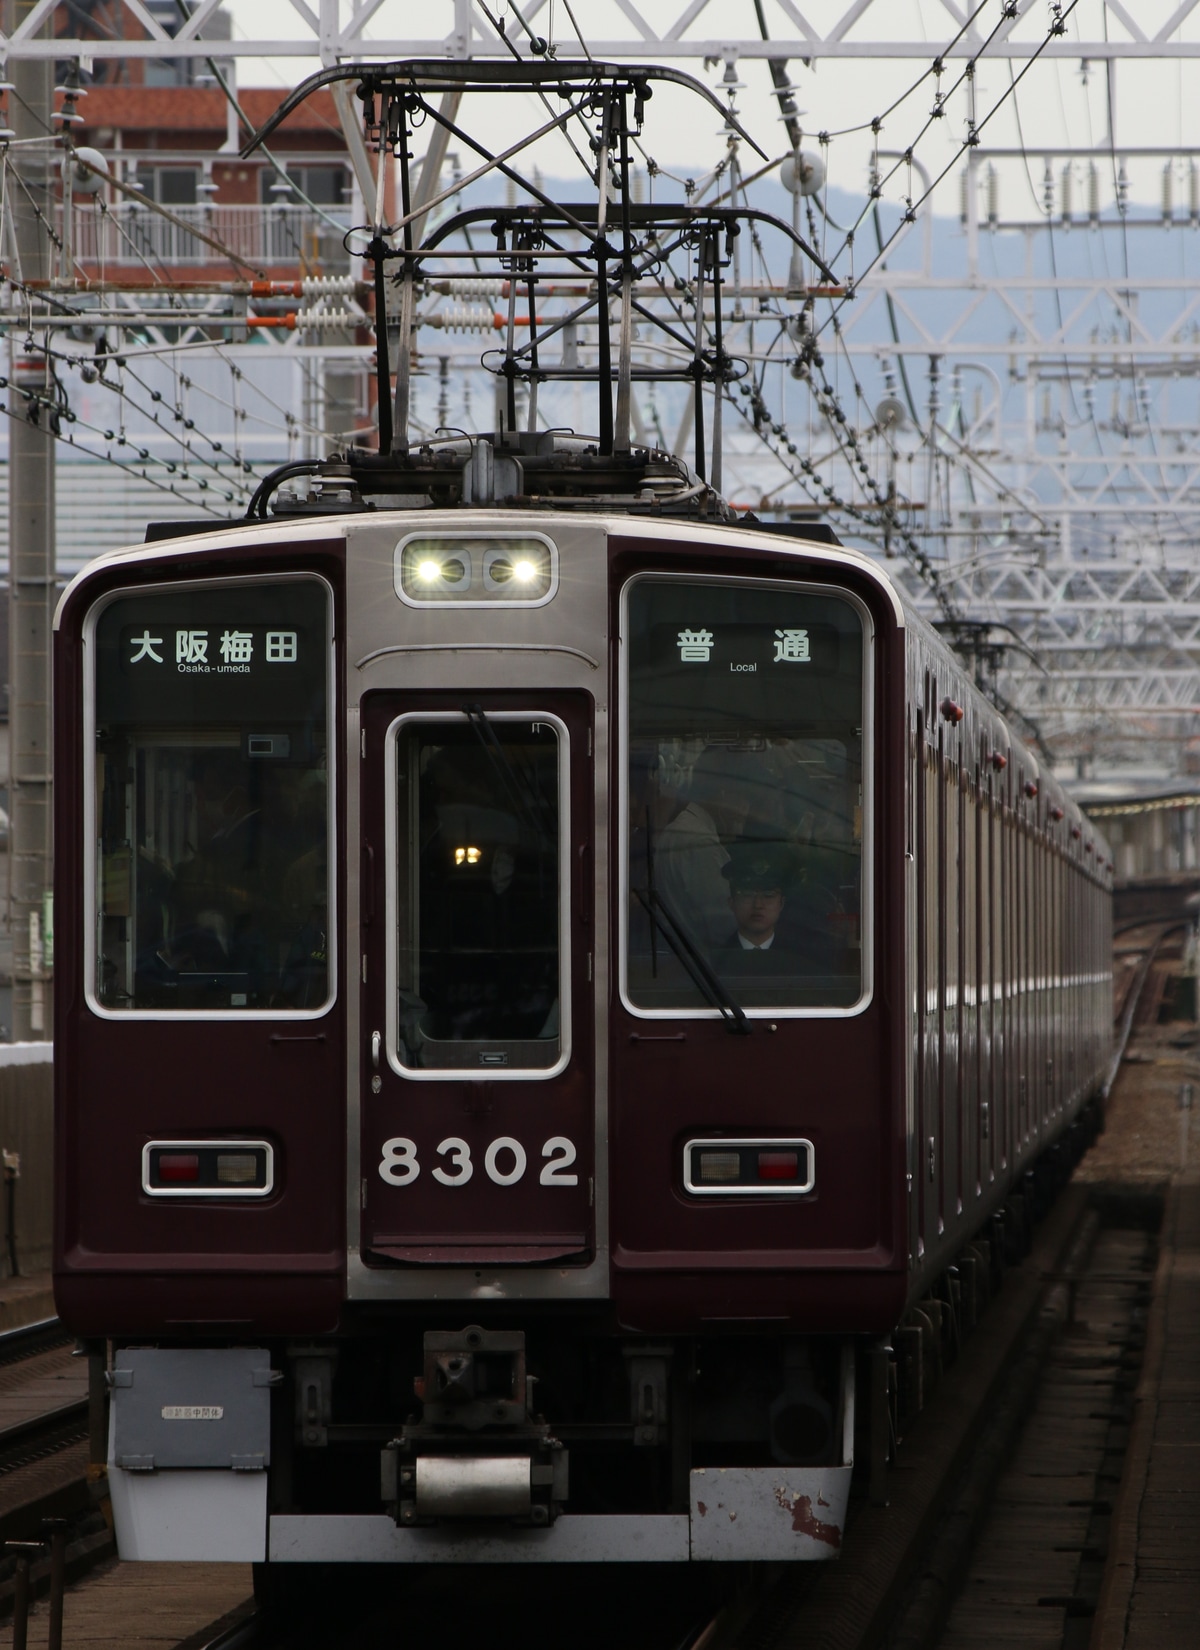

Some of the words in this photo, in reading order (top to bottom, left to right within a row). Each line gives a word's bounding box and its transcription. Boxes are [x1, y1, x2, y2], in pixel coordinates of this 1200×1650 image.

[130, 630, 297, 663] 大阪梅田
[676, 628, 811, 662] 普通
[177, 663, 250, 673] Osaka-umeda
[730, 662, 757, 672] Local
[378, 1136, 578, 1186] 8302
